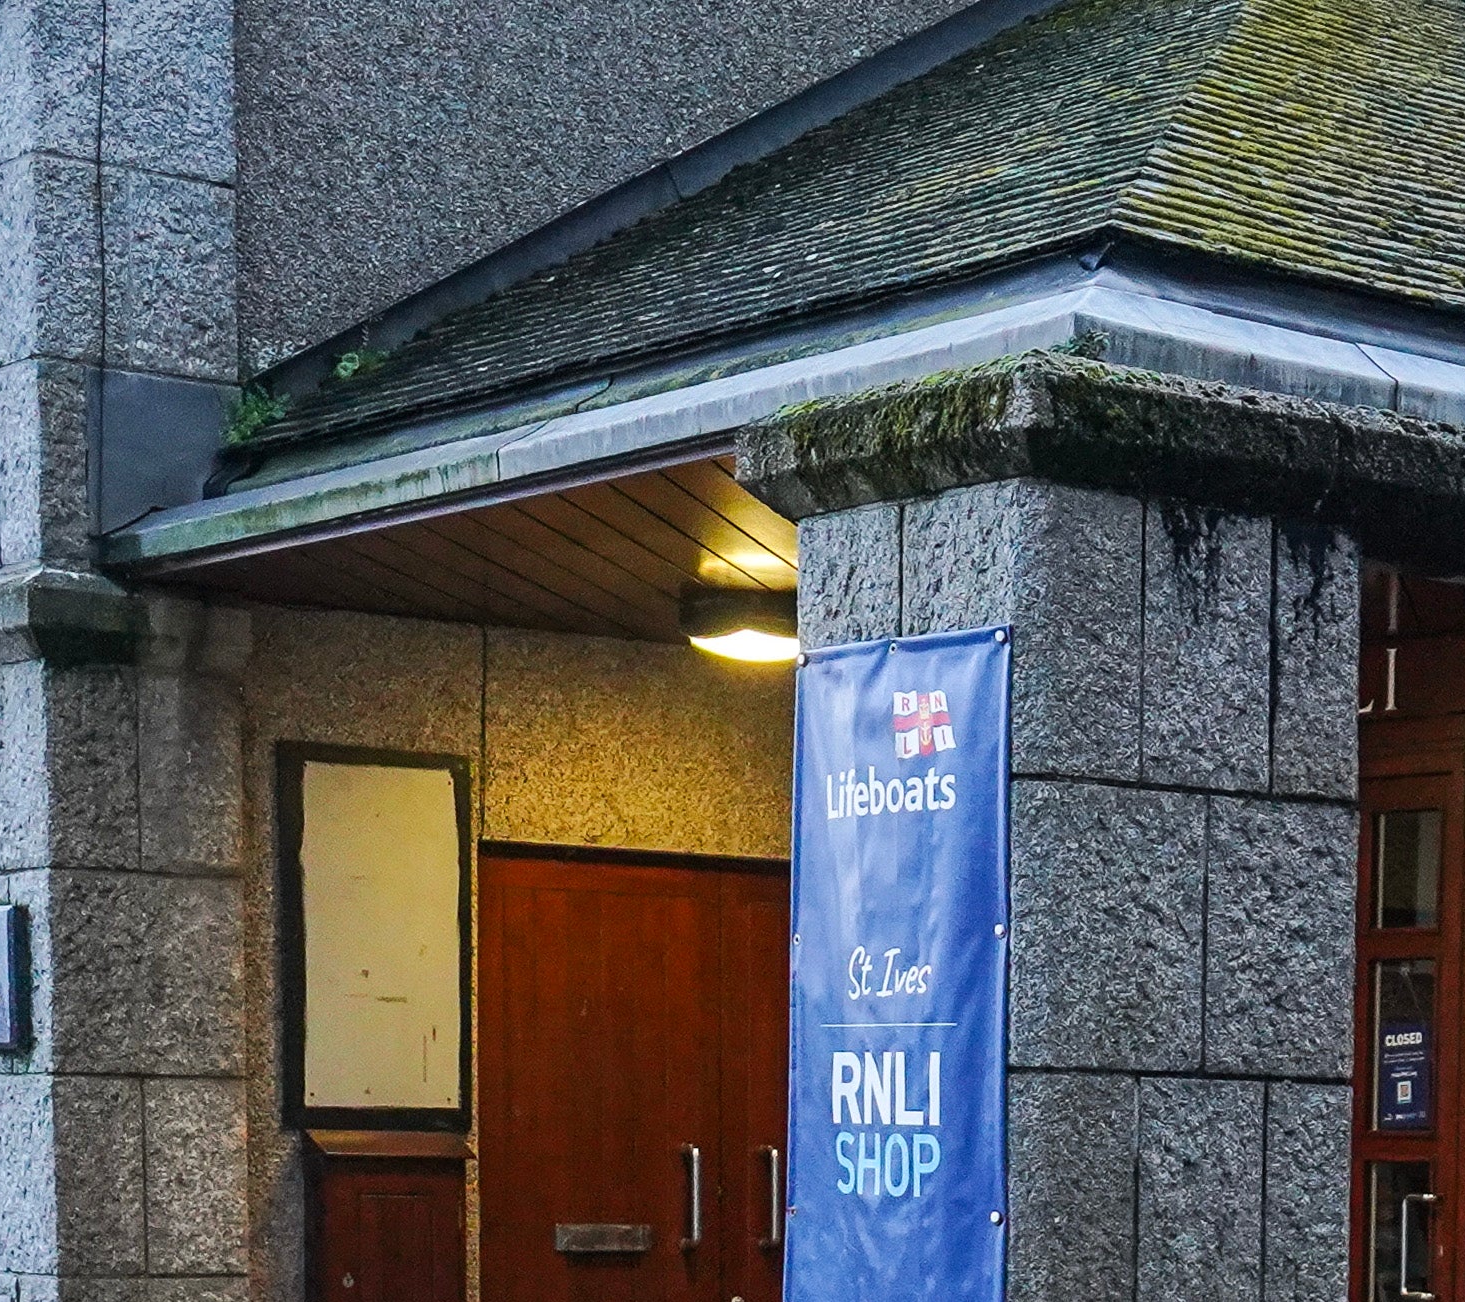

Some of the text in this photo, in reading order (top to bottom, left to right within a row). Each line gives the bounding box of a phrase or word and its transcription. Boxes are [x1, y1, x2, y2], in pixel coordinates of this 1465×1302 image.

[825, 766, 957, 820] Lifeboats
[847, 946, 933, 1001] St Ives
[1385, 1031, 1423, 1047] CLOSED
[831, 1051, 942, 1126] RNLI
[835, 1132, 942, 1198] SHOP
